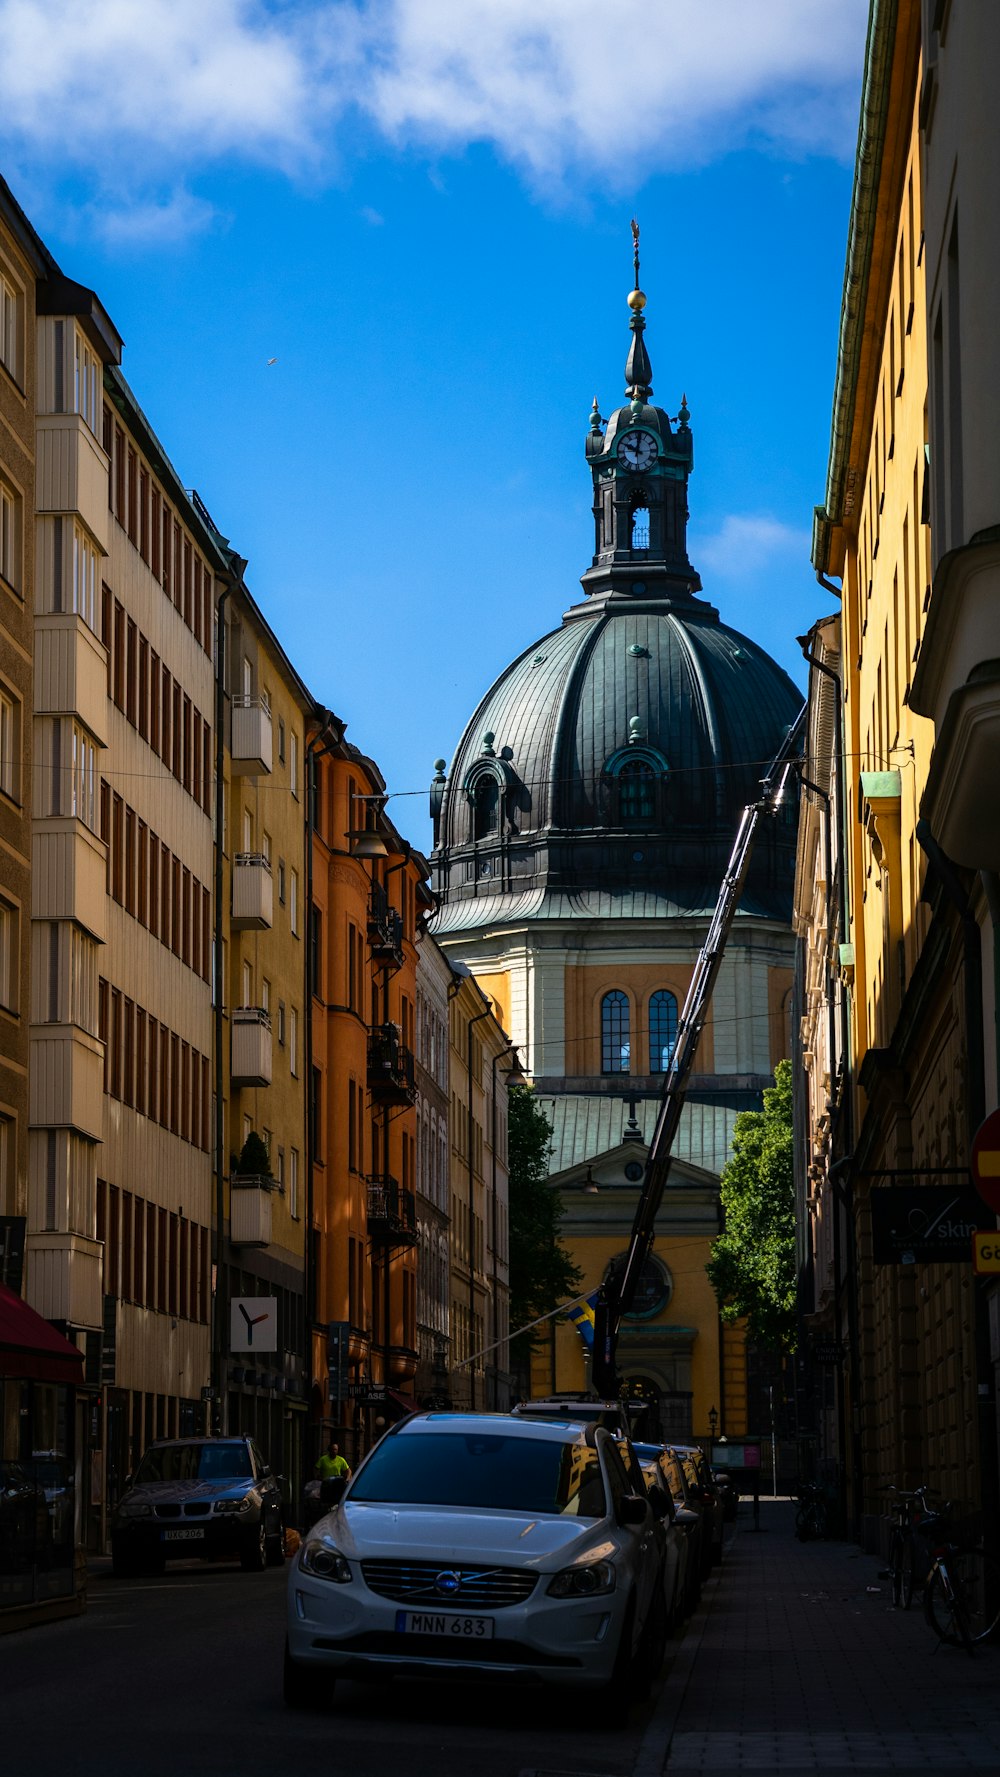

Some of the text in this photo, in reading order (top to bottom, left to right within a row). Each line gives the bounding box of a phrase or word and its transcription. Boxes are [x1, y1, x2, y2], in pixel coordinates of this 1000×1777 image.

[185, 1529, 202, 1538] 206
[411, 1615, 486, 1636] MNN 683
